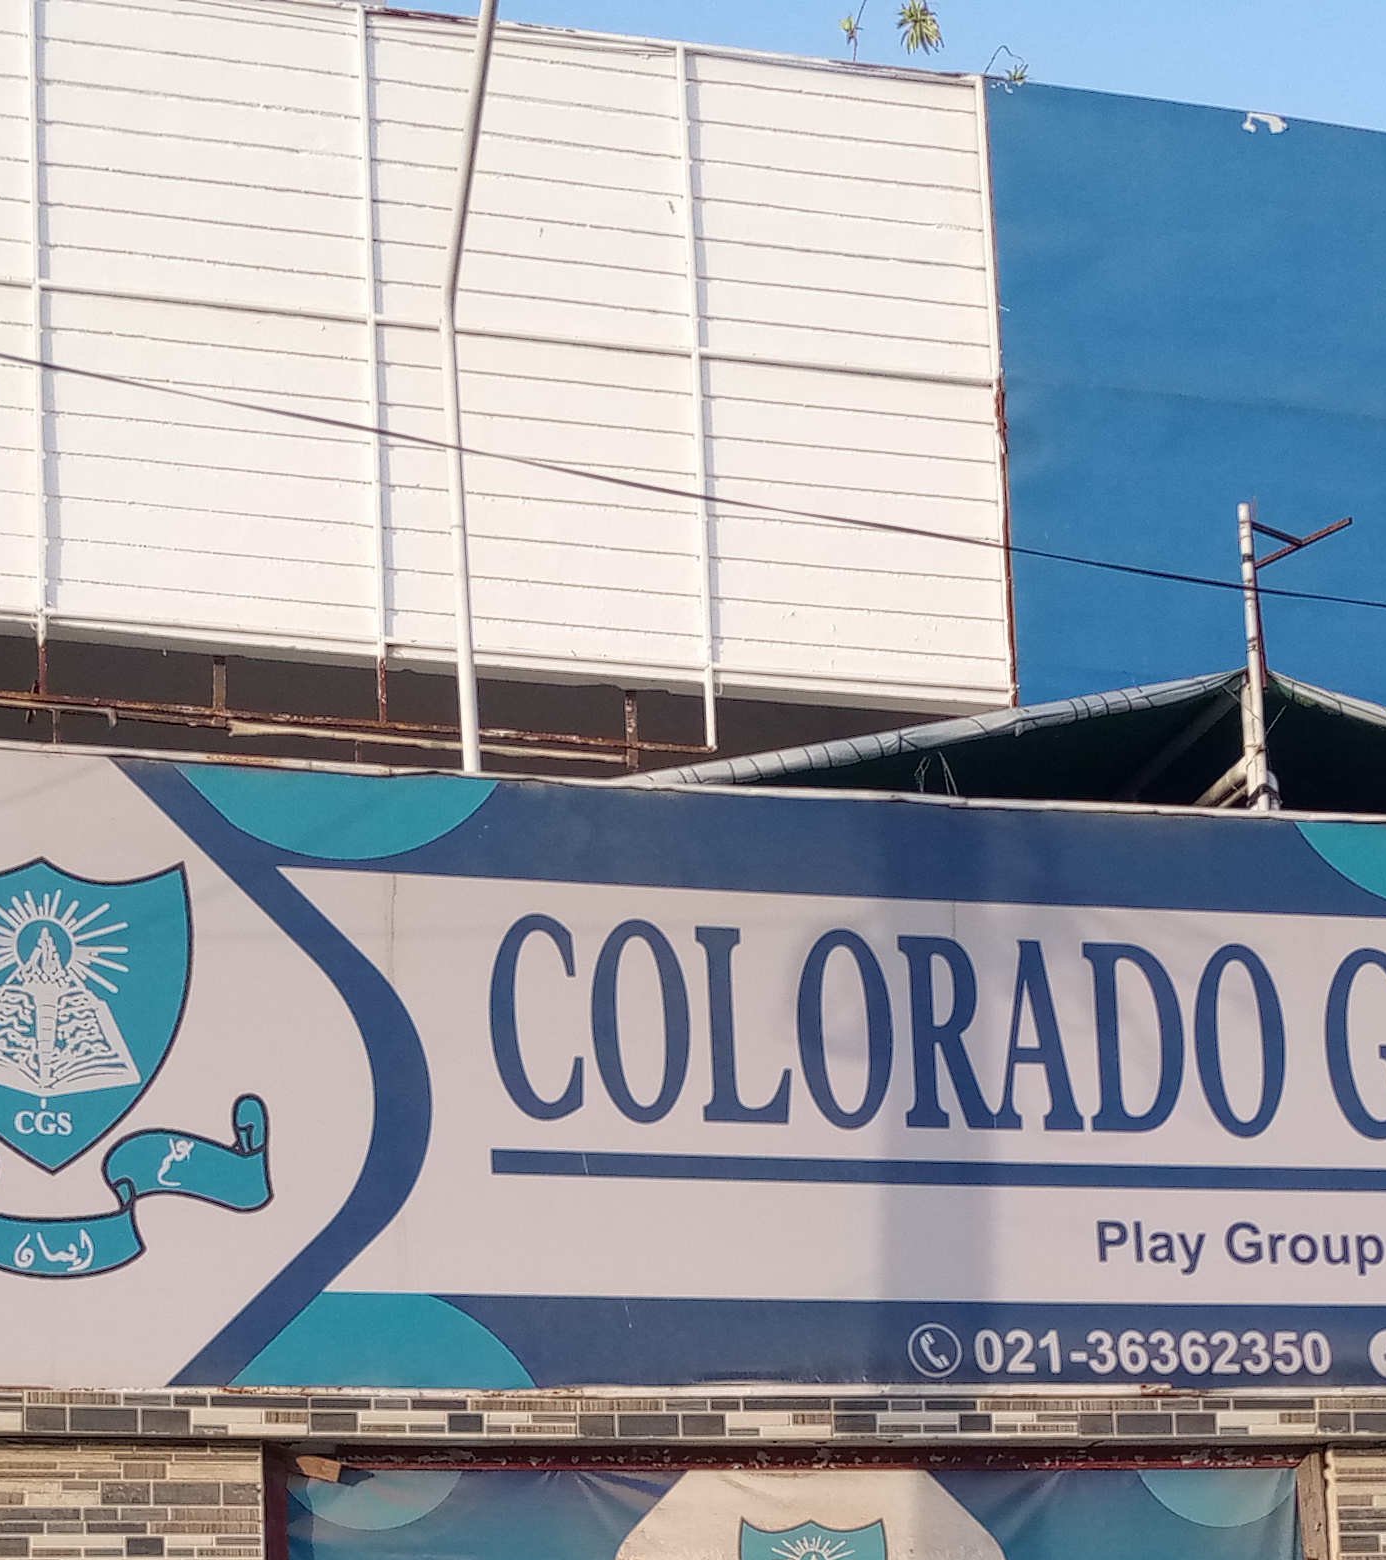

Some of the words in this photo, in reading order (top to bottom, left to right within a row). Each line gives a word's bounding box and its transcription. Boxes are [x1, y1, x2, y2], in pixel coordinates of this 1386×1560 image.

[489, 914, 1286, 1139] COLORADO
[14, 1110, 73, 1137] CGS
[1096, 1220, 1206, 1276] Play
[1225, 1221, 1384, 1276] Group
[973, 1328, 1333, 1376] 021-36362350
